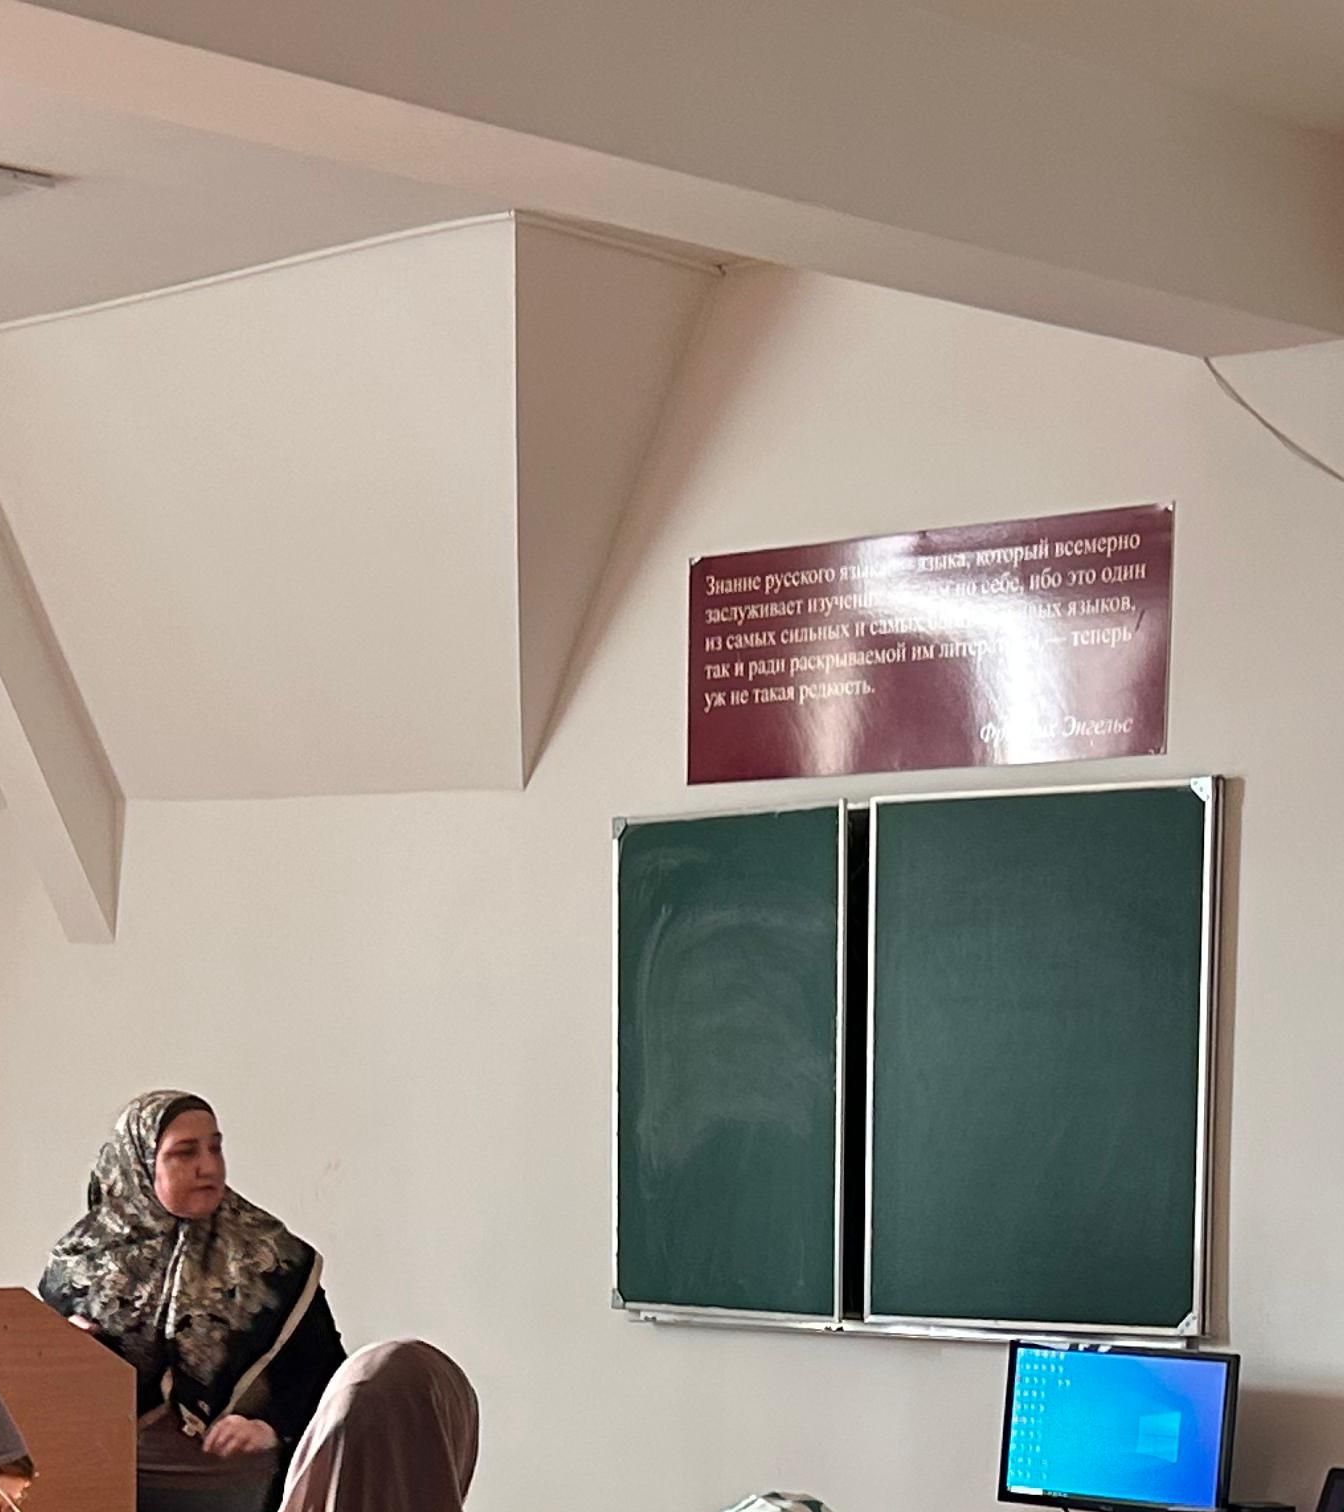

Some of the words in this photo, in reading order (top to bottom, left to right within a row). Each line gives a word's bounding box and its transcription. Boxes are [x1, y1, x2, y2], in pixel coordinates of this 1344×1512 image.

[706, 575, 761, 596] Знание
[764, 567, 836, 594] русского
[976, 537, 1050, 567] который
[1054, 533, 1141, 558] всемерно
[705, 599, 804, 626] заслуживает
[1030, 567, 1062, 589] ибо
[1068, 569, 1095, 587] это
[1101, 563, 1147, 584] один
[706, 636, 722, 652] из
[726, 632, 777, 650] самых
[780, 625, 850, 645] сильных
[855, 623, 865, 638] и
[1067, 596, 1136, 617] языков,
[705, 661, 730, 680] так
[748, 657, 785, 681] ради
[790, 642, 907, 677] раскрываемой
[912, 643, 935, 660] им
[1071, 624, 1132, 648] теперь
[704, 691, 727, 713] уж
[731, 689, 749, 705] не
[754, 685, 795, 704] такая
[799, 678, 876, 705] редкость.
[1062, 715, 1134, 736] Энгельс
